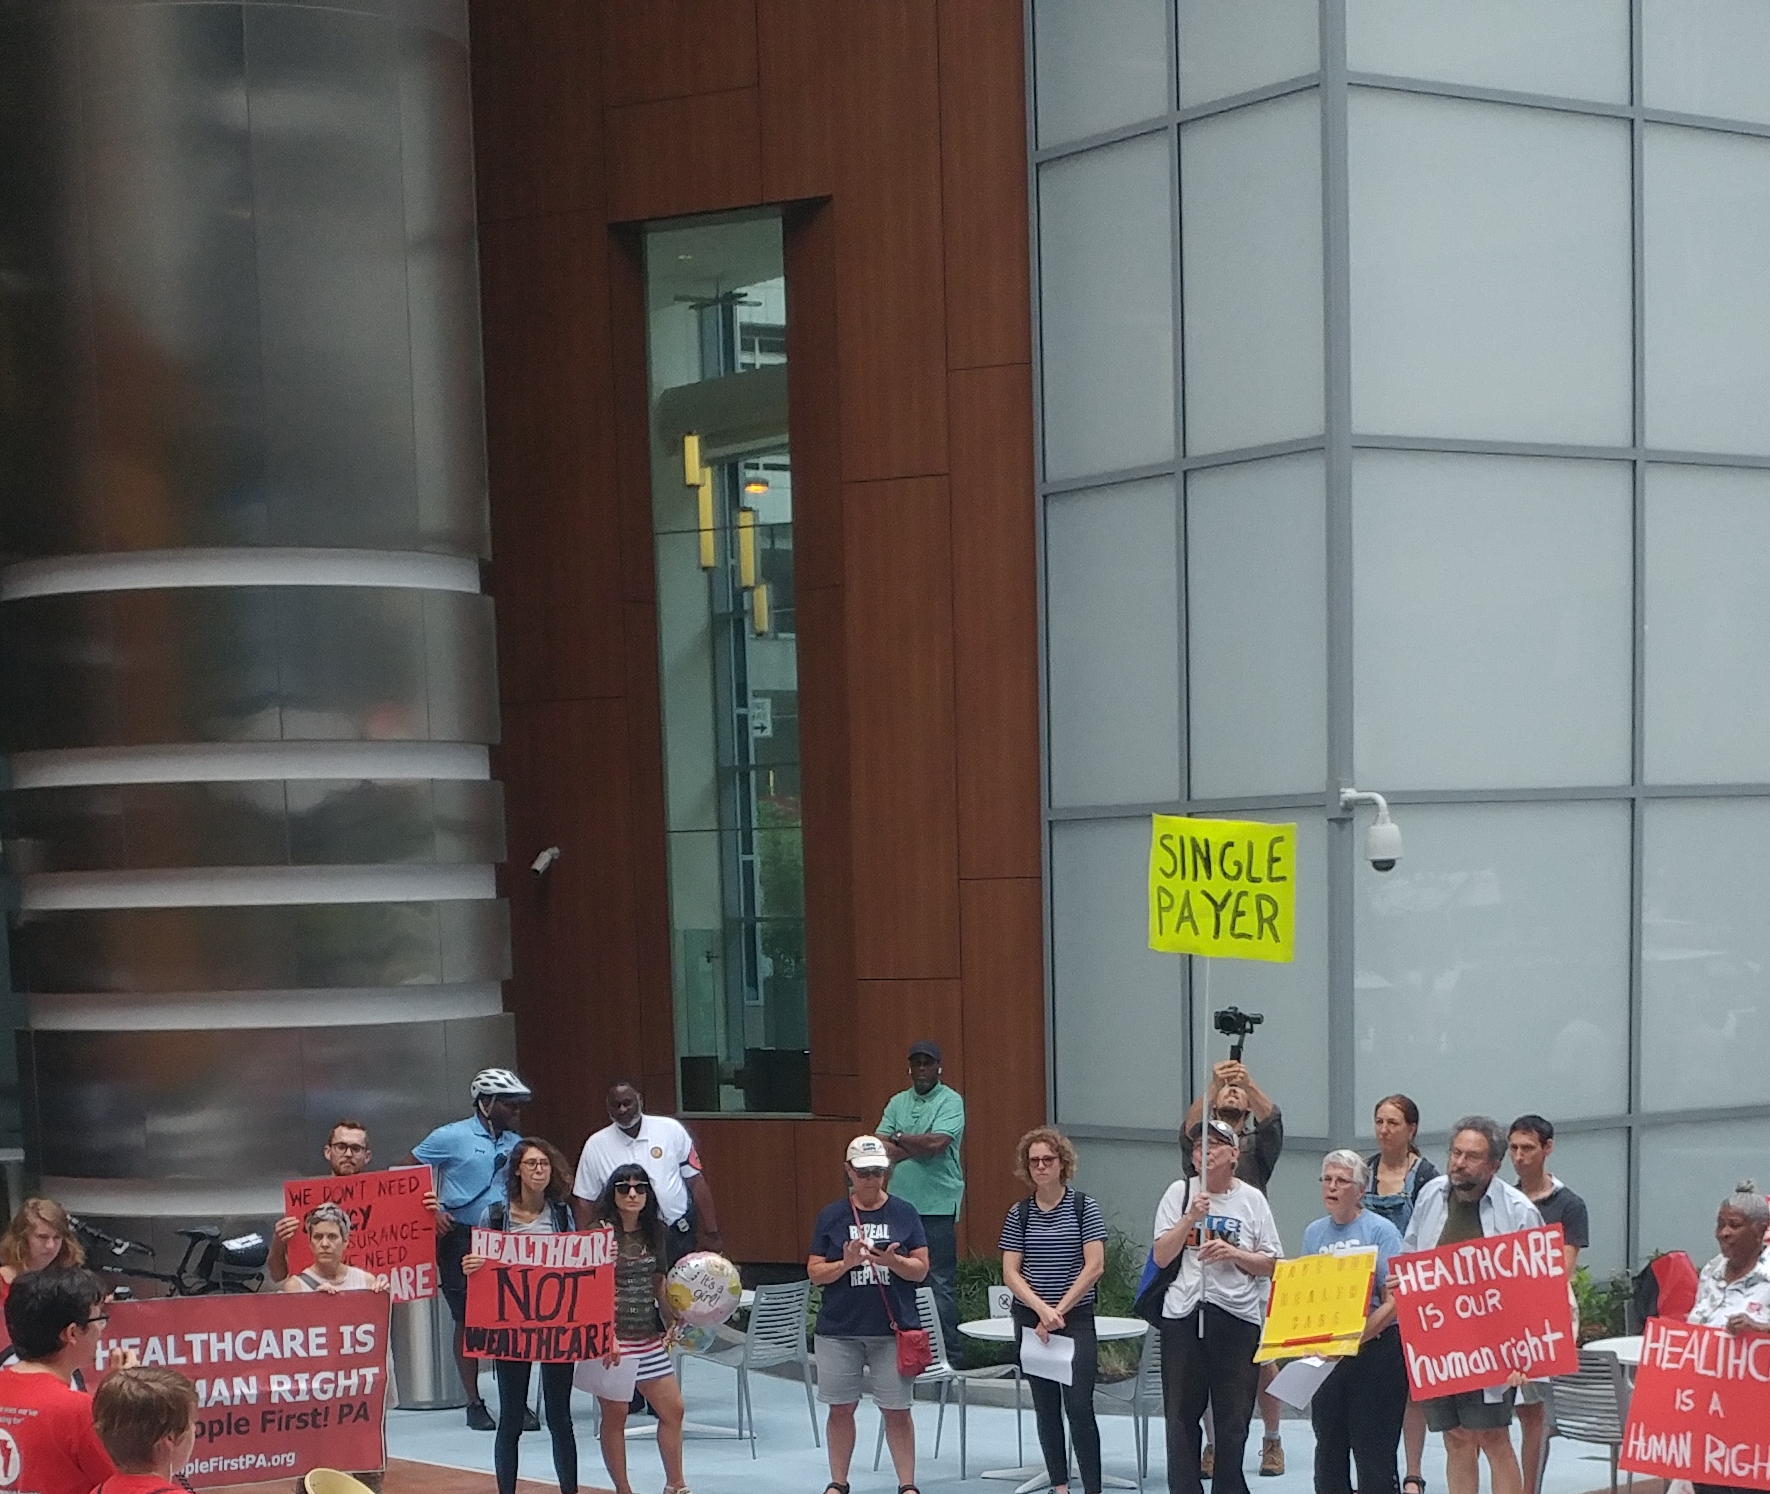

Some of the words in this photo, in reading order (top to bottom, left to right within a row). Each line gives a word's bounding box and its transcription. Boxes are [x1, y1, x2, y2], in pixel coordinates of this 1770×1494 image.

[1159, 834, 1287, 883] SINGLE
[1157, 885, 1280, 943] PAYER
[289, 1188, 312, 1207] WE
[323, 1180, 366, 1204] DON'T
[378, 1176, 420, 1196] NEED
[366, 1246, 408, 1268] NEED
[472, 1229, 615, 1268] HEALTHCARE
[1395, 1230, 1564, 1295] HEALTHCARE
[492, 1267, 596, 1322] NOT
[692, 1289, 721, 1308] girl!
[700, 1274, 716, 1290] It's
[717, 1285, 725, 1293] a
[1417, 1303, 1445, 1331] IS
[1455, 1288, 1503, 1319] OUR
[95, 1326, 328, 1371] HEALTHCARE
[339, 1323, 376, 1355] IS
[465, 1321, 611, 1360] WEALTHCARE
[1406, 1342, 1498, 1389] human
[1499, 1319, 1564, 1373] right
[270, 1367, 379, 1405] RIGHT
[1675, 1388, 1695, 1412] IS
[1708, 1391, 1725, 1419] A
[195, 1412, 249, 1443] ople
[261, 1406, 328, 1434] First!
[337, 1401, 370, 1426] PA
[1627, 1421, 1692, 1468] HUMAN
[176, 1452, 296, 1478] pleFirstPA.org
